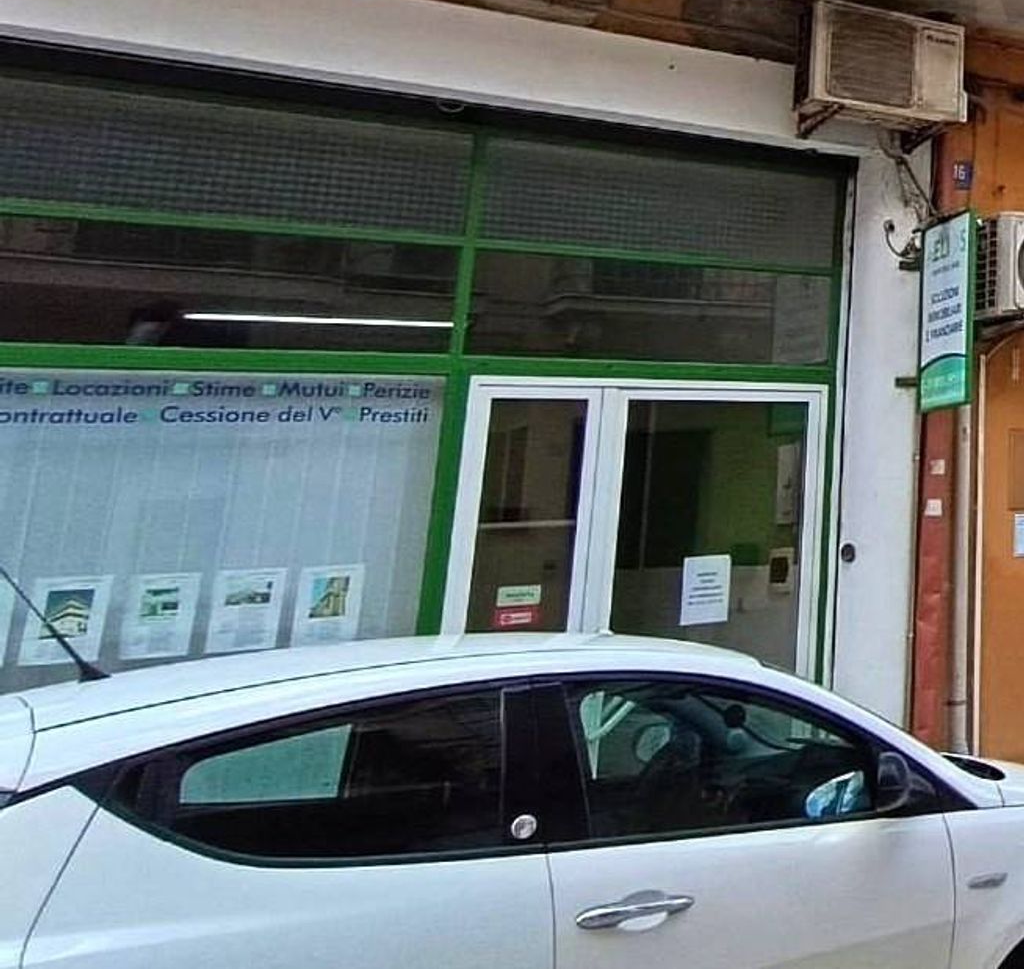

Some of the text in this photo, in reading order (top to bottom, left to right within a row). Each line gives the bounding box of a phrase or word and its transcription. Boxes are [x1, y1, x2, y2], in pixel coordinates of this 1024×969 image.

[953, 163, 967, 181] 16
[53, 379, 168, 397] Locazioni
[191, 380, 257, 398] Stime
[278, 381, 345, 398] Mutui
[362, 381, 431, 399] Perizie
[0, 406, 138, 425] ontrattuale
[159, 405, 270, 424] Cessione
[278, 405, 313, 423] del
[359, 406, 429, 424] Prestiti
